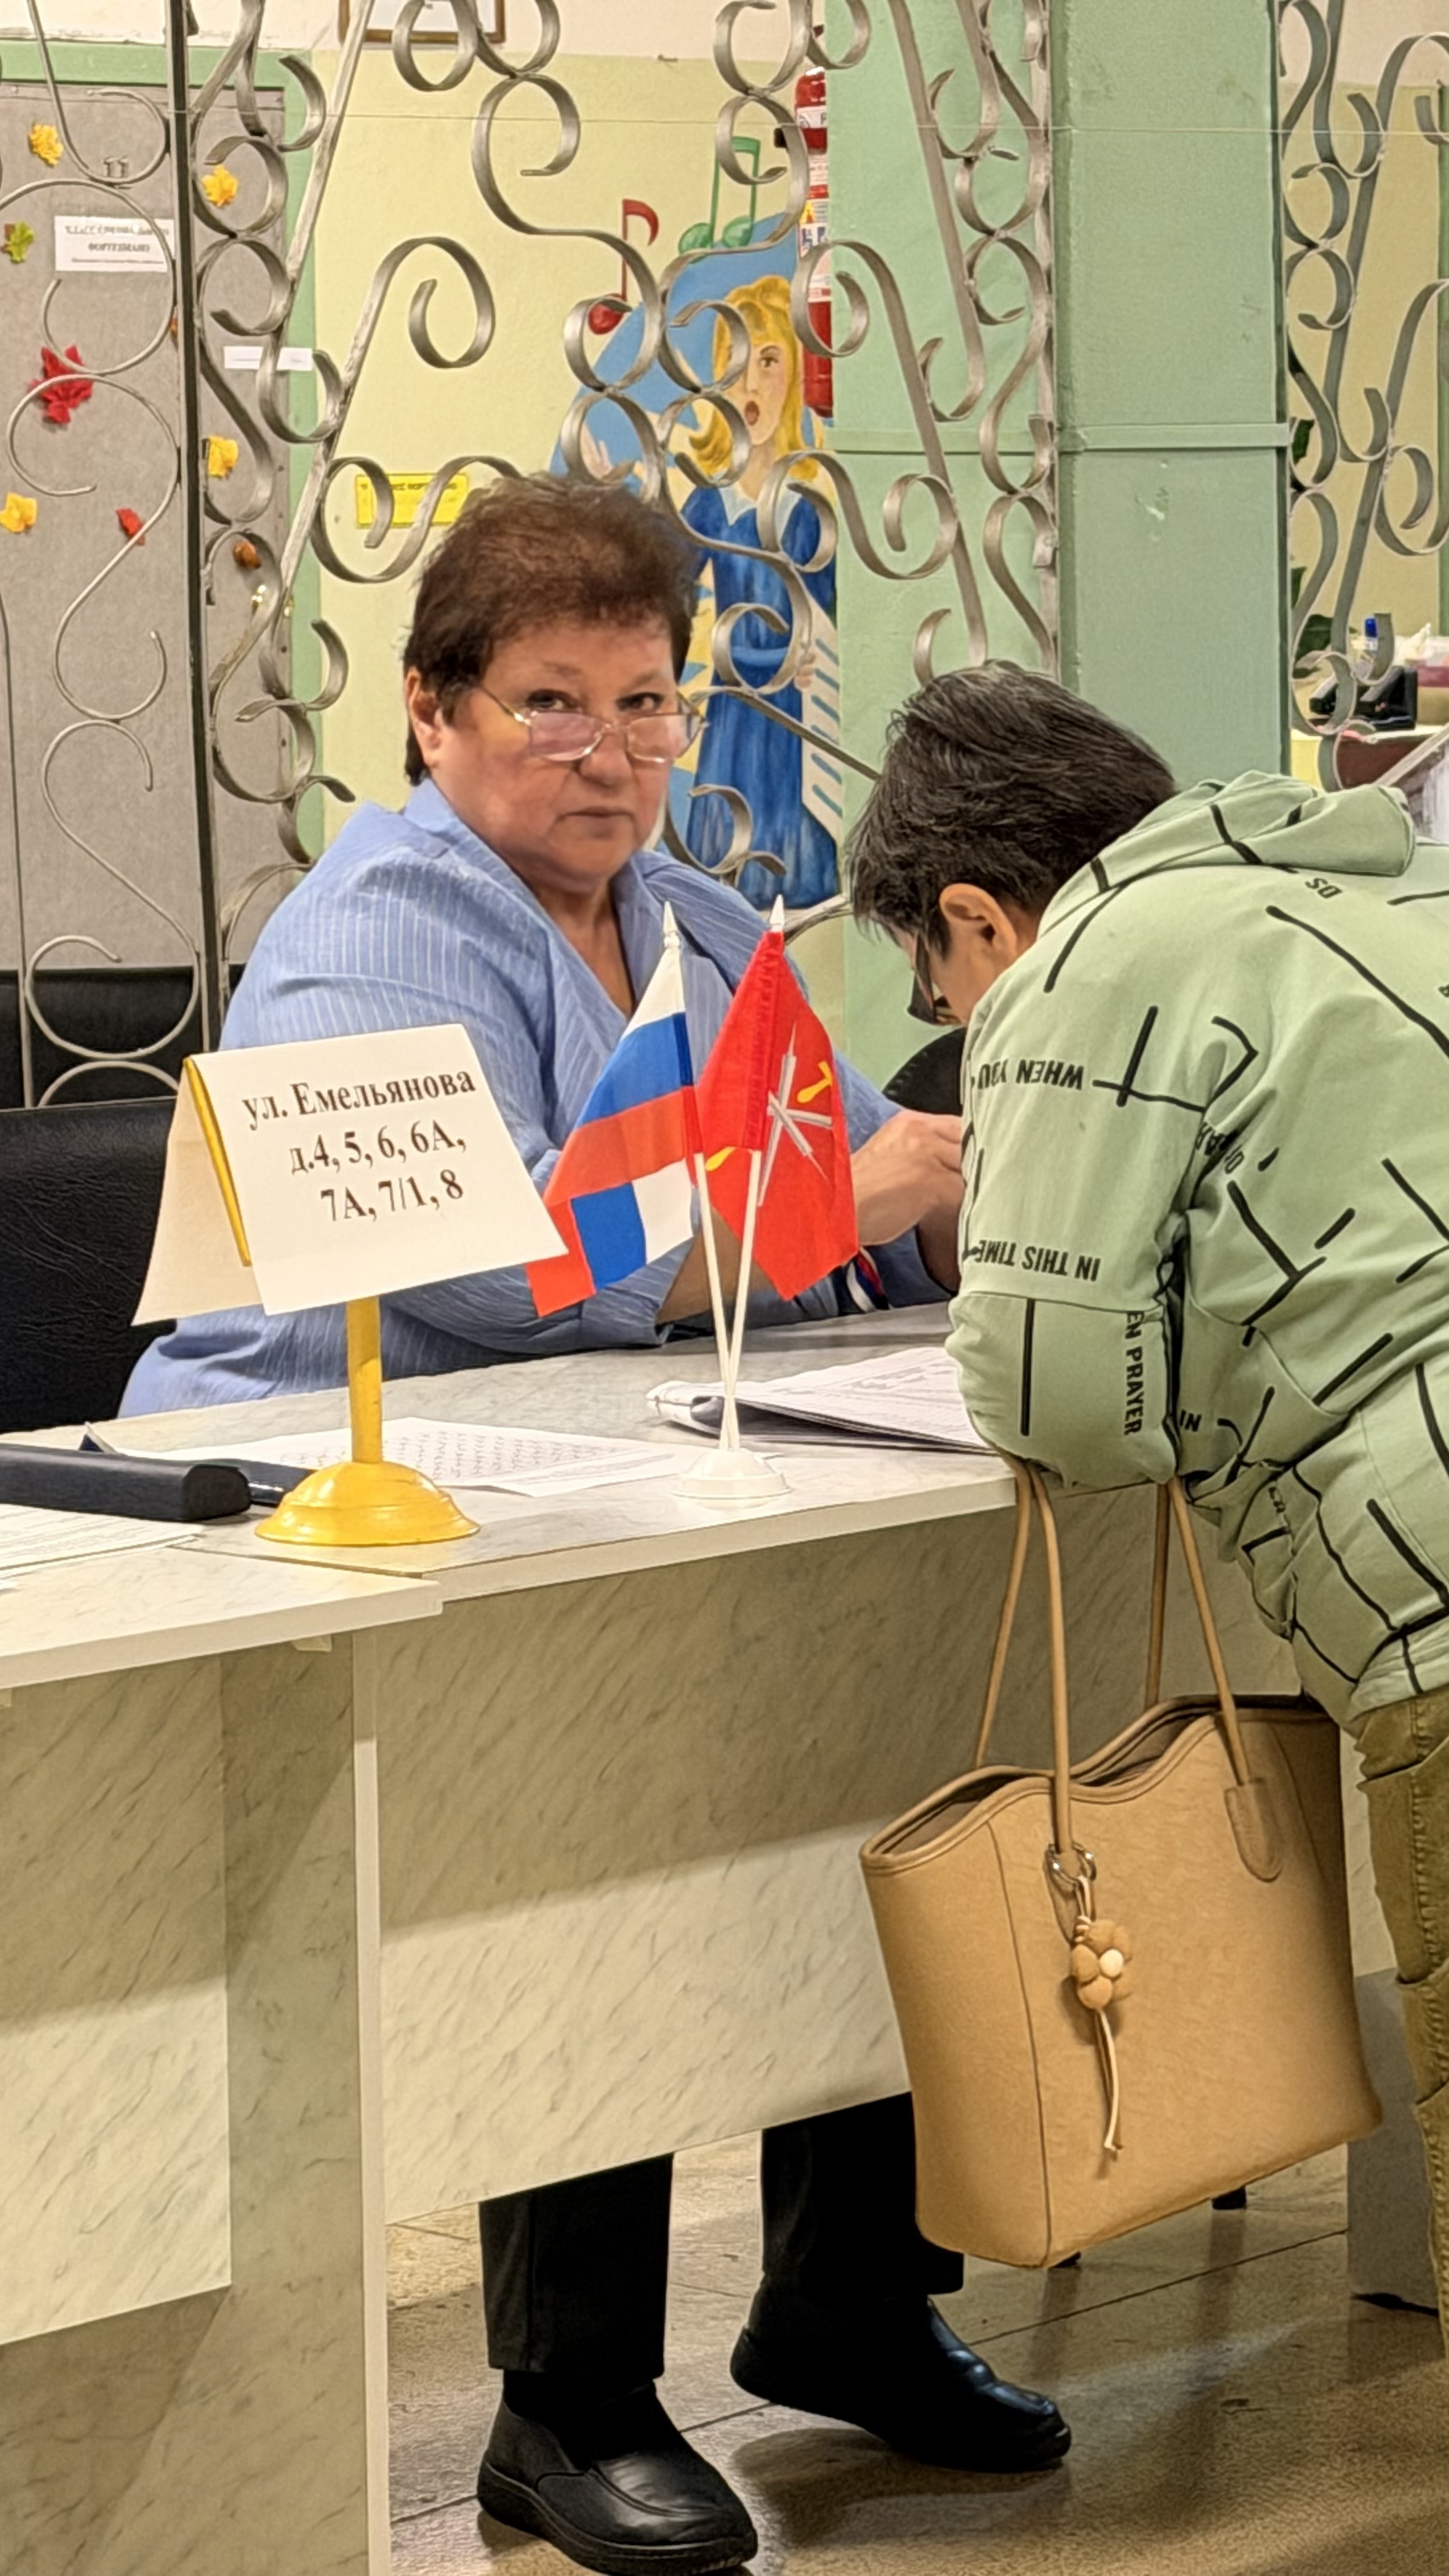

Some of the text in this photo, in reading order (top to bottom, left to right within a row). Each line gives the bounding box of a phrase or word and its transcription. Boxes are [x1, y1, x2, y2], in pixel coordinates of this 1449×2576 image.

[242, 1070, 476, 1131] ул. Емельянова
[1016, 1059, 1084, 1091] WHEN
[344, 1131, 373, 1168] 5,
[377, 1125, 406, 1163] 6,
[410, 1119, 467, 1153] 6А,
[320, 1169, 464, 1222] 7А, 7/1, 8
[974, 1239, 1101, 1282] IN THIS TIME
[1123, 1346, 1145, 1436] PRAYER
